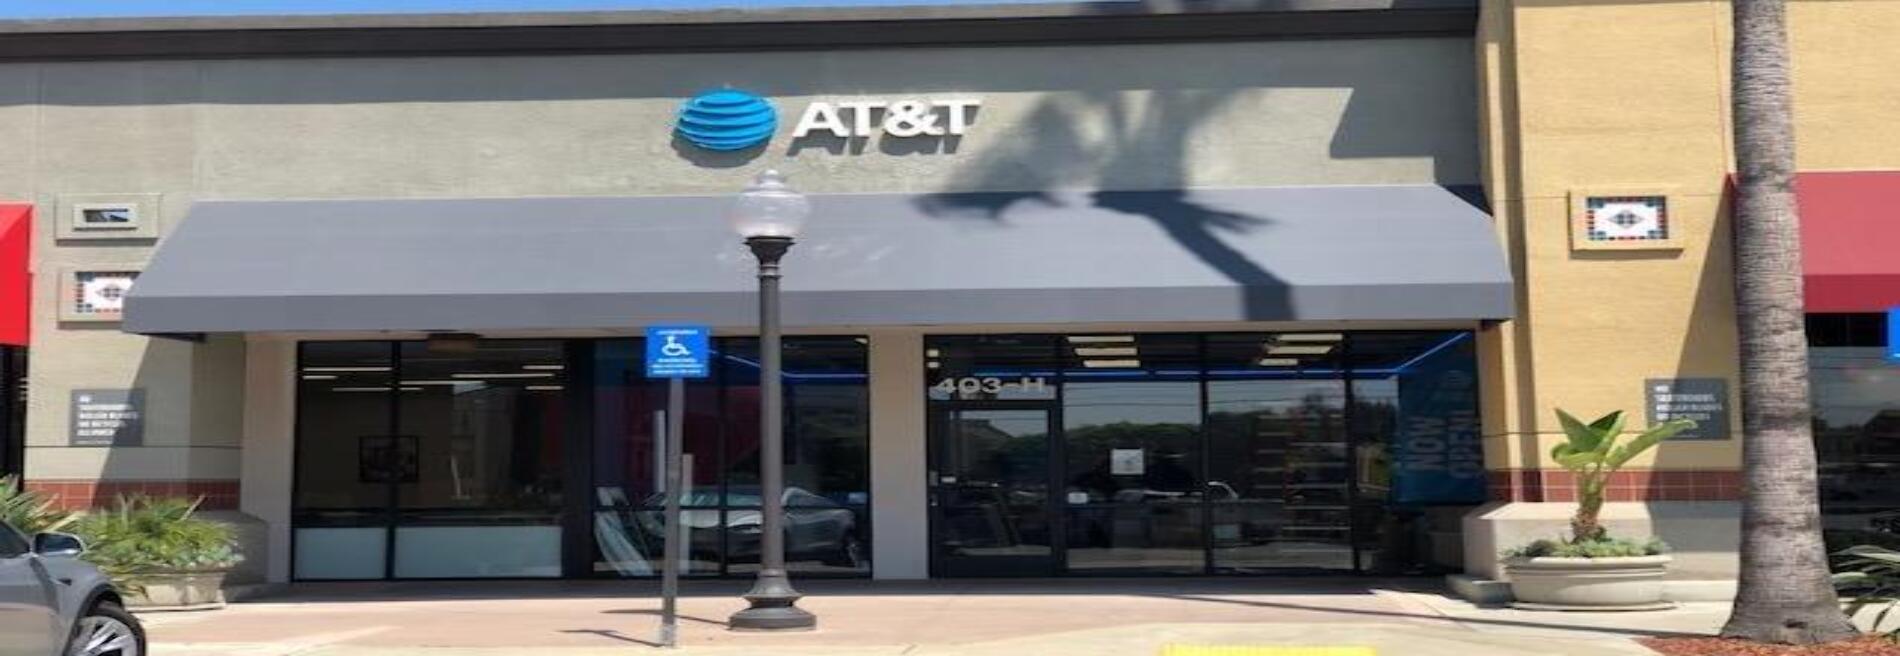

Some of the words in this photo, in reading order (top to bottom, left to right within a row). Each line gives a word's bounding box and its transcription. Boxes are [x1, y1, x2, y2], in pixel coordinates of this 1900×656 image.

[791, 98, 981, 138] AT&T
[935, 376, 1045, 393] 403-H
[1405, 416, 1446, 471] NOW
[1449, 410, 1480, 480] OPEN
